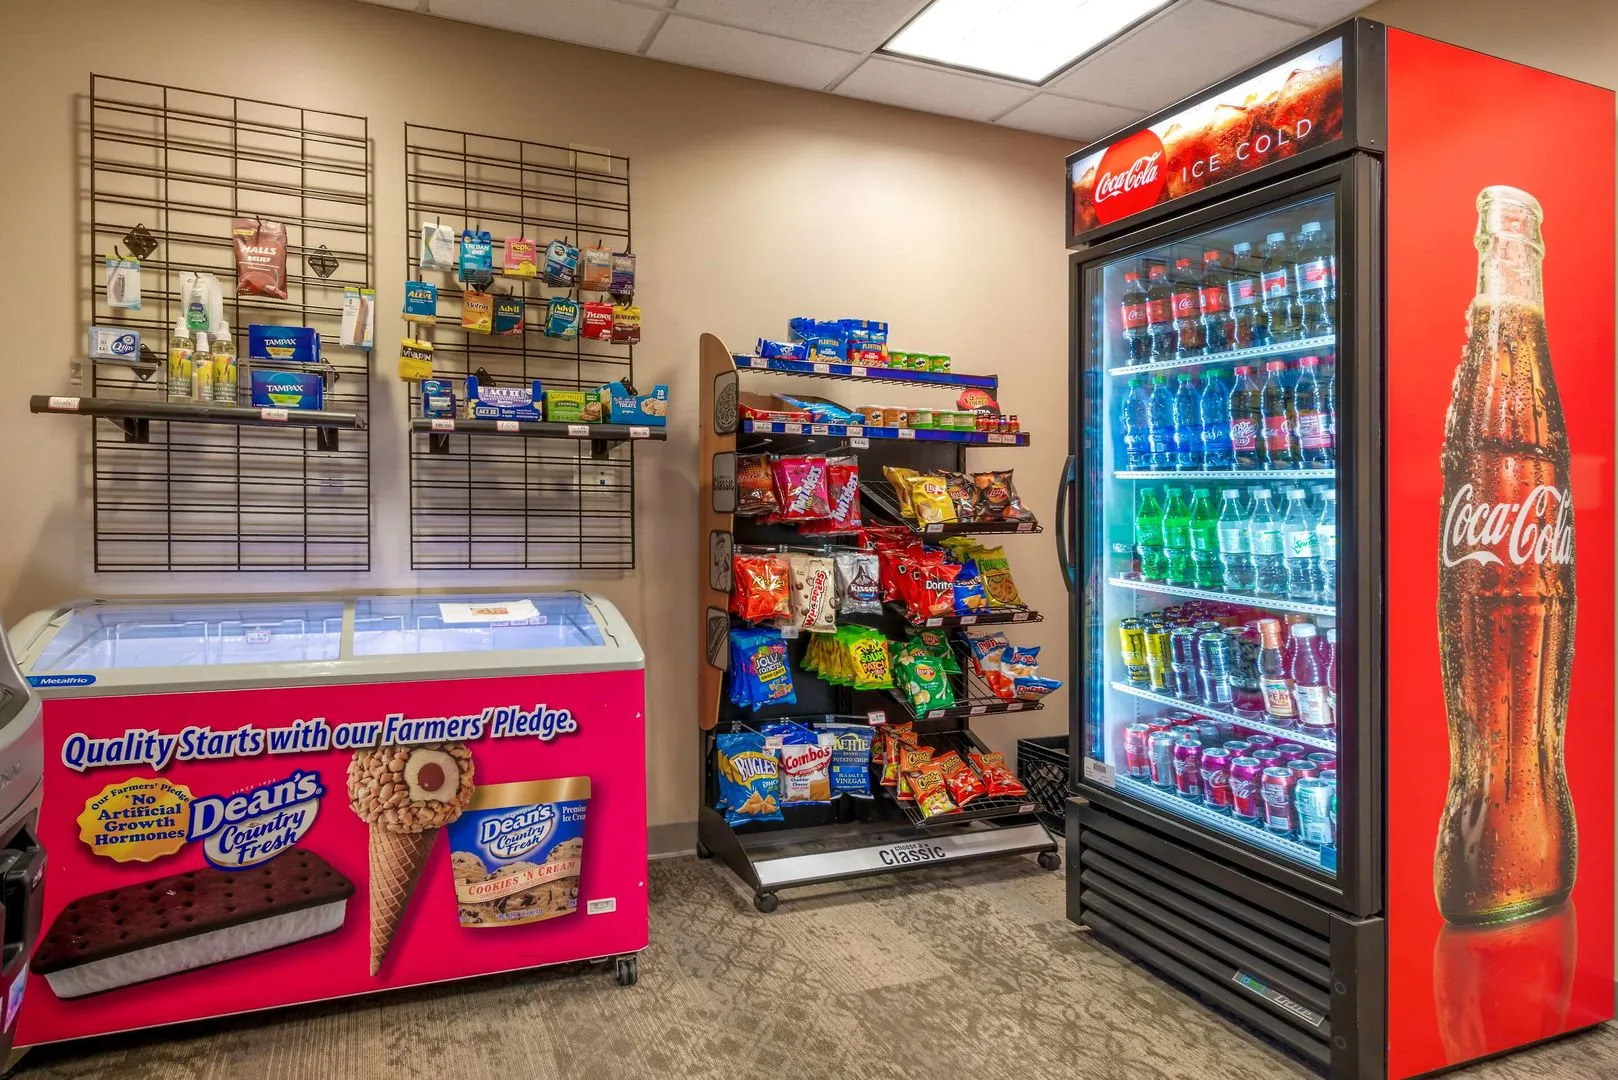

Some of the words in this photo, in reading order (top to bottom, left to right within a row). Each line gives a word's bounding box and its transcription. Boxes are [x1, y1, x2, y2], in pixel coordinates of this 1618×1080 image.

[1095, 149, 1162, 204] Coca-Cola
[1182, 153, 1221, 183] ICE
[1236, 118, 1314, 162] COLD
[240, 246, 278, 256] HALLS
[511, 243, 532, 251] Pepto
[247, 255, 271, 263] RELIEF
[408, 291, 432, 299] ALEVE
[466, 300, 489, 310] Motrin
[498, 304, 520, 313] Advil
[555, 304, 575, 313] Advil
[263, 338, 297, 346] TAMPAX
[403, 348, 432, 361] VIVARIN
[266, 385, 304, 393] TAMPAX
[489, 389, 508, 397] ACT
[1443, 484, 1573, 569] Coca-Cola
[925, 580, 955, 591] Dorito
[804, 570, 827, 628] WHOPPERS
[756, 652, 780, 668] JOLLY
[860, 653, 885, 664] SOUR
[863, 660, 886, 673] PATCH
[40, 677, 88, 686] Metalfrio
[64, 730, 175, 768] Quality
[179, 725, 262, 758] Starts
[270, 720, 328, 751] with
[335, 724, 379, 746] our
[384, 710, 490, 743] Farmers'
[493, 706, 576, 739] Pledge.
[785, 746, 830, 771] Combos
[734, 756, 777, 783] BUGLES
[91, 793, 112, 810] Our
[160, 784, 191, 804] Pledge
[97, 803, 183, 821] Artificial
[190, 772, 318, 841] Dean's
[562, 805, 587, 815] Premiu
[104, 816, 176, 833] Growth
[482, 804, 556, 843] Dean's
[562, 814, 572, 823] Ice
[572, 813, 586, 822] Crea
[94, 829, 186, 847] Hormones
[219, 809, 307, 854] Country
[497, 825, 546, 849] Country
[235, 828, 299, 865] Fresh
[507, 837, 541, 856] Fresh
[894, 844, 917, 852] choose
[878, 843, 946, 867] Classic
[468, 877, 520, 897] COOKIES
[538, 861, 576, 878] CREAM
